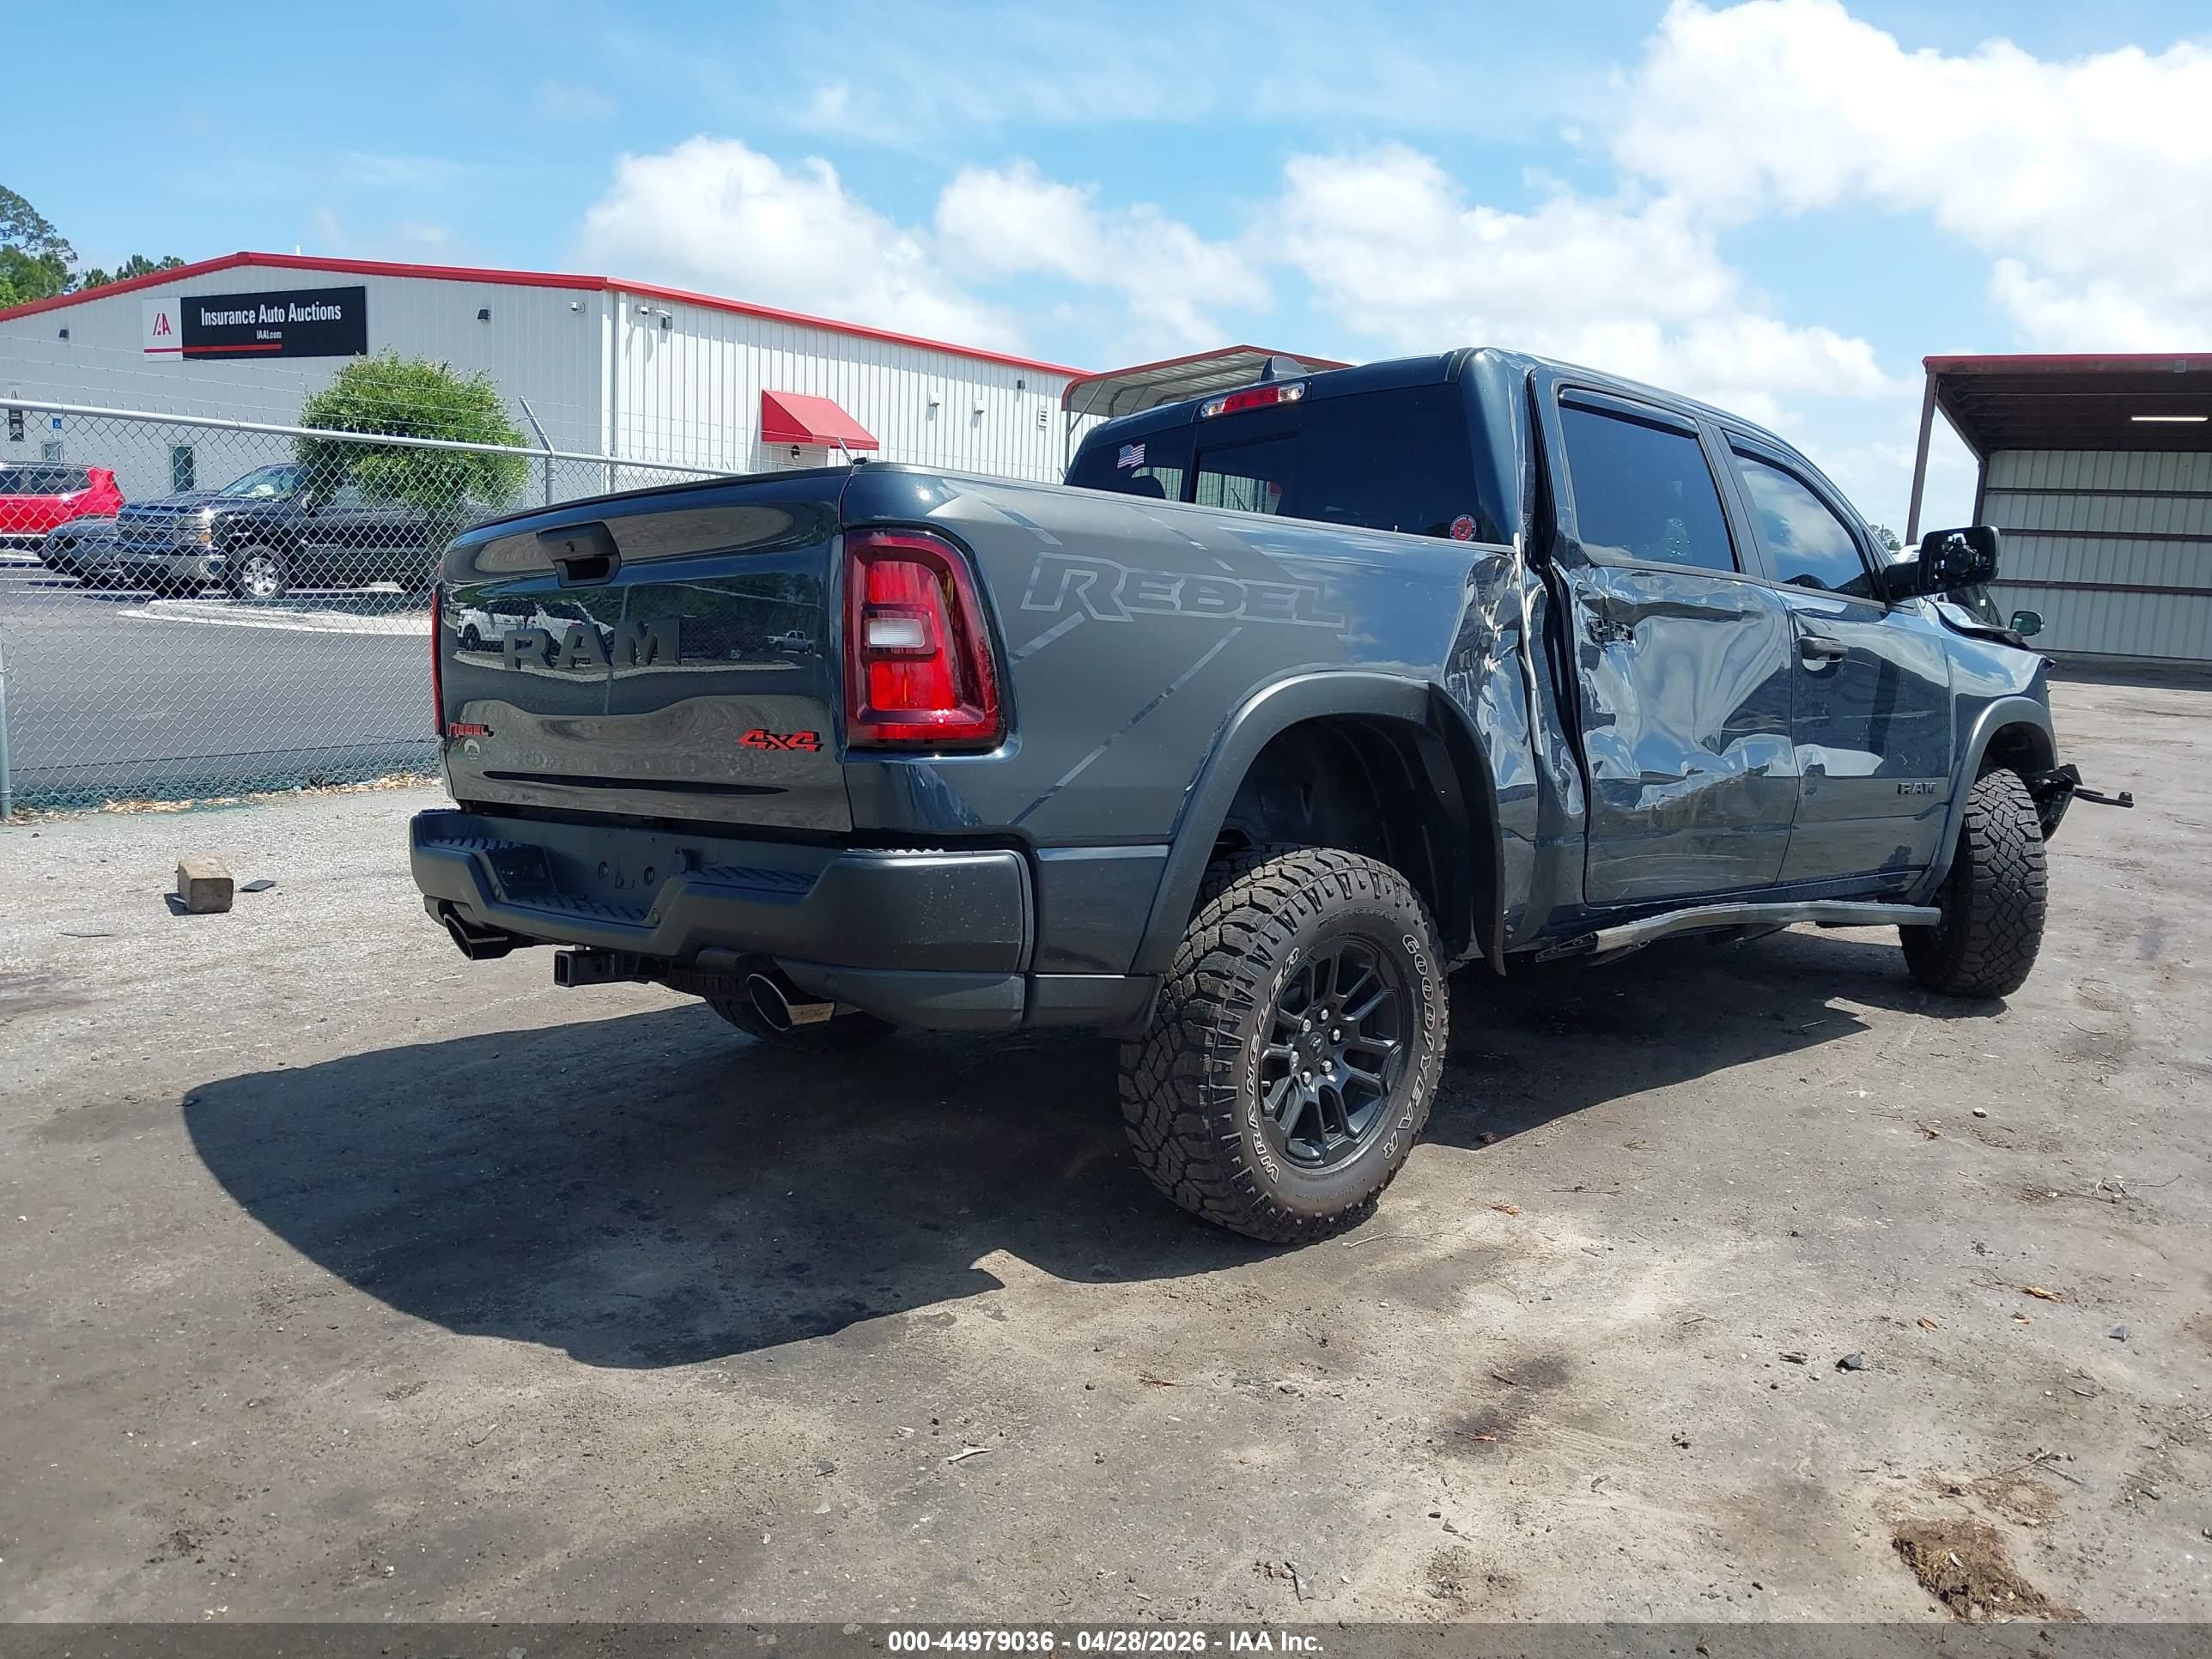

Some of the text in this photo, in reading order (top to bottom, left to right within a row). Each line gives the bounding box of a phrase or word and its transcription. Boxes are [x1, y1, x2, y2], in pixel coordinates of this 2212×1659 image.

[201, 301, 343, 326] Insurance Auto Auctions
[1020, 552, 1346, 629] REBEL
[503, 617, 682, 670] RAM
[1244, 946, 1301, 1184] WRANGLER
[1381, 933, 1437, 1162] GOODYEAR
